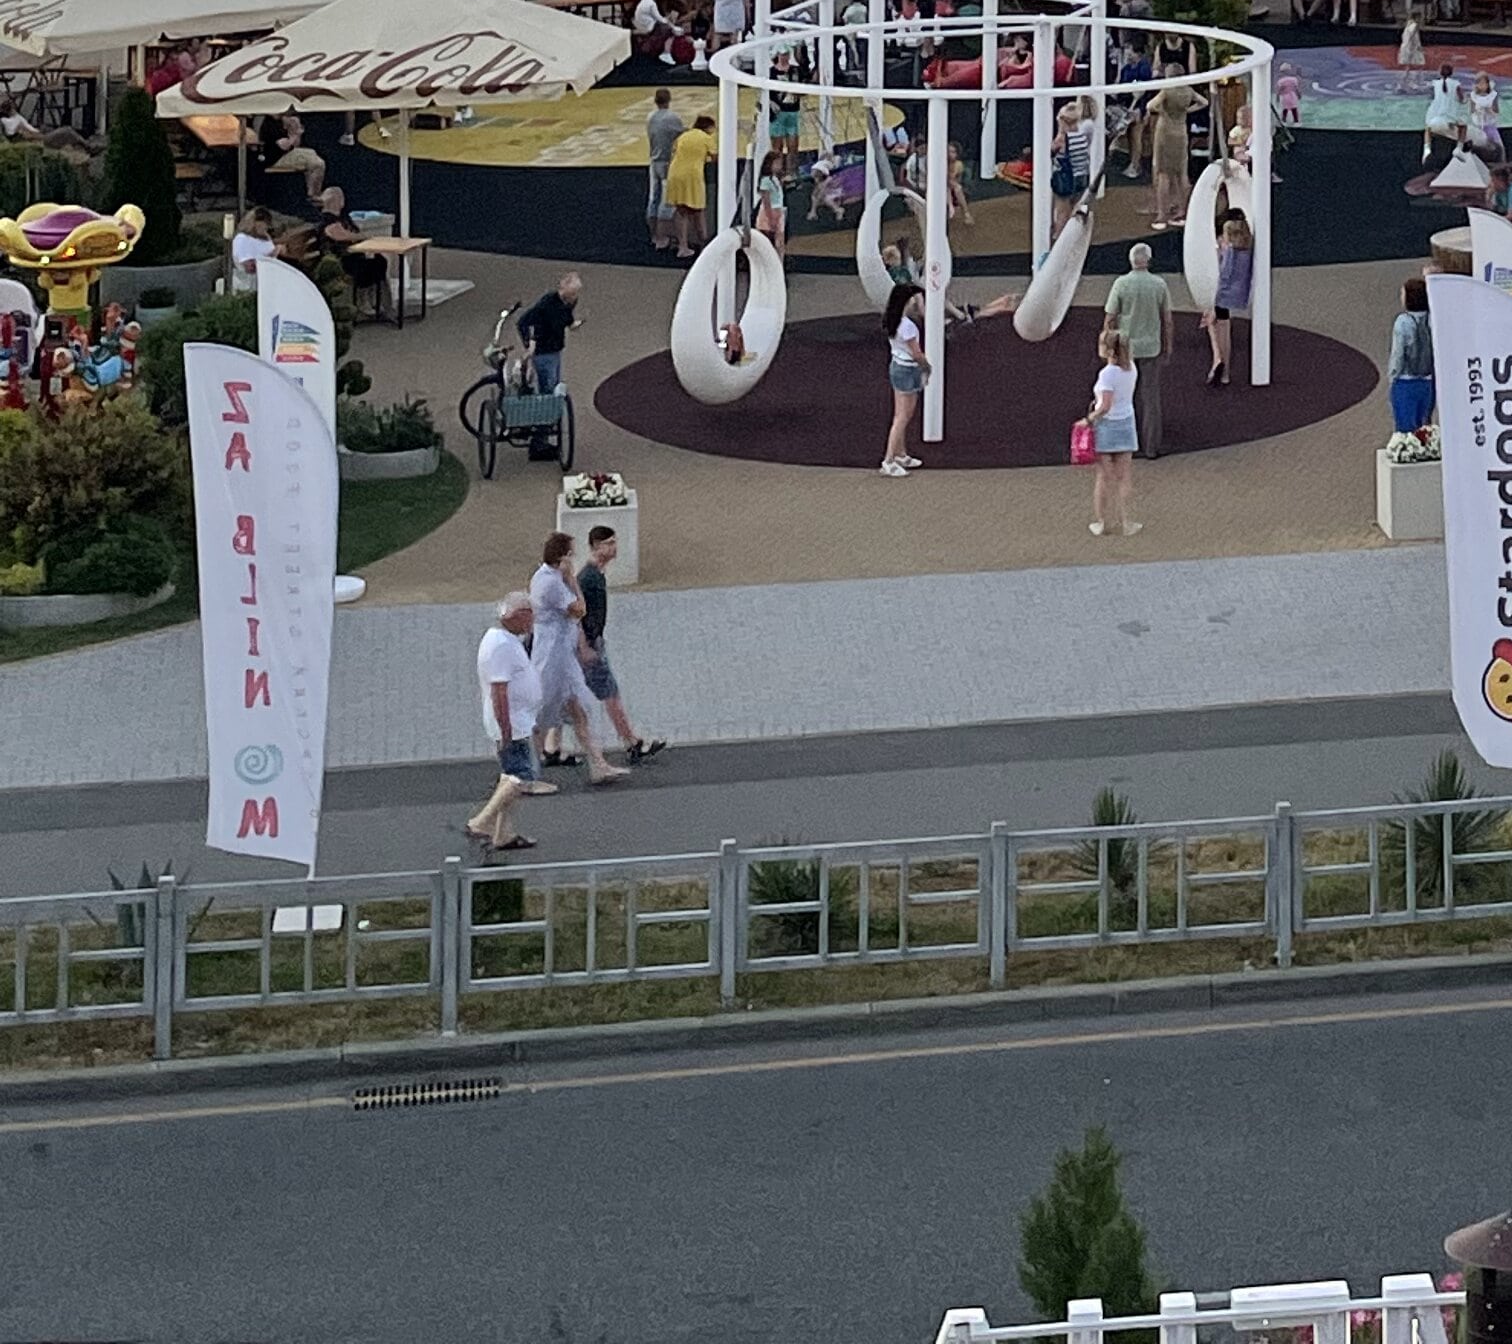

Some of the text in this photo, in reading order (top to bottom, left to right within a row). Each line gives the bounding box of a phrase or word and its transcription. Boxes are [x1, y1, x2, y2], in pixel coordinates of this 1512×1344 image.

[180, 29, 547, 104] Coca-Cola
[1467, 356, 1486, 447] est. 1993
